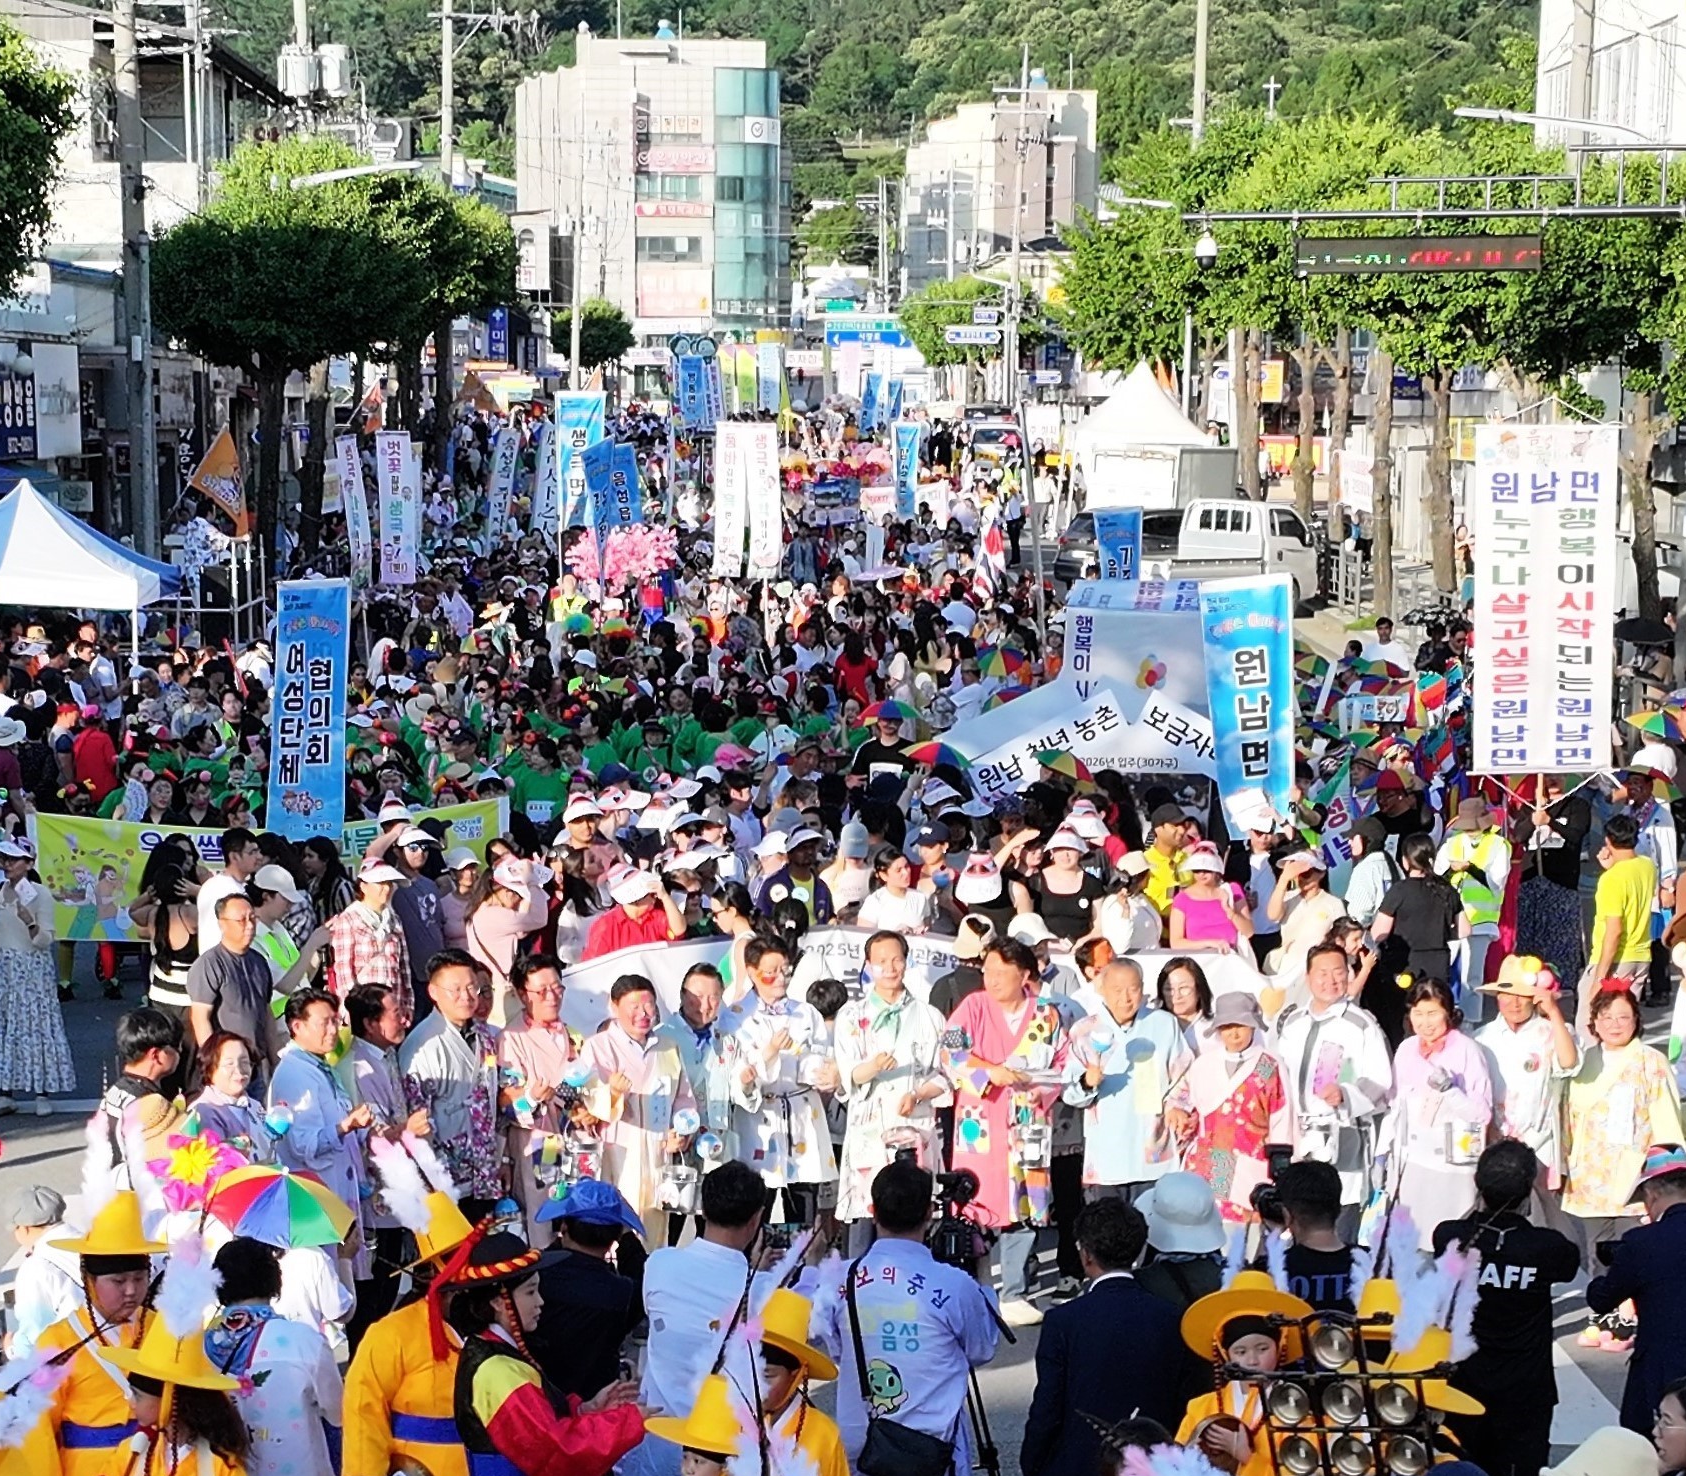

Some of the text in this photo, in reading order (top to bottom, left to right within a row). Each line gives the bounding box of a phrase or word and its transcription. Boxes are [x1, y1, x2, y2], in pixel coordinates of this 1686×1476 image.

[1491, 472, 1599, 503] 원남면
[1073, 616, 1094, 673] 행복이
[1491, 509, 1531, 767] 누구나 살고싶은 원남면
[1555, 508, 1596, 766] 행복이 시작되는 원남면
[279, 643, 305, 786] 여성단체
[305, 658, 332, 765] 협의회
[978, 754, 1025, 793] 원남
[1074, 705, 1119, 742] 농촌
[1143, 706, 1216, 760] 보금자
[1234, 648, 1272, 778] 원남면
[1117, 756, 1179, 770] 입주(30가구)
[882, 1322, 920, 1353] 음성
